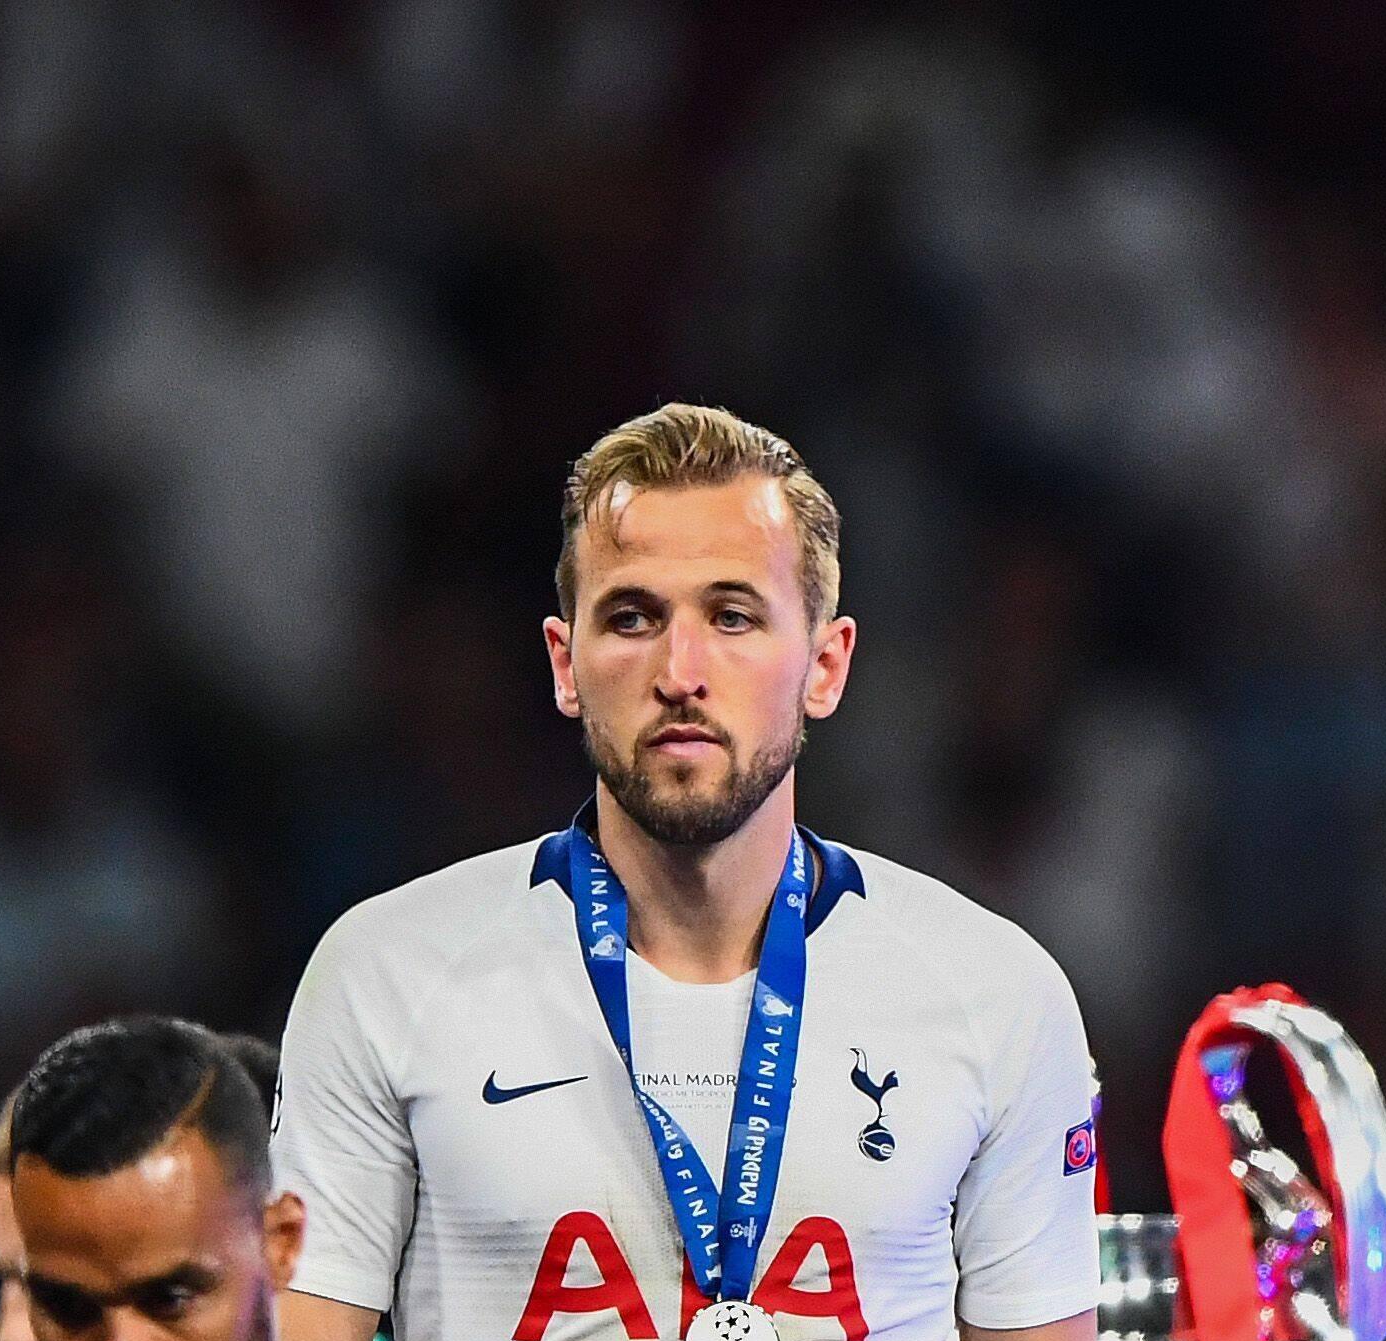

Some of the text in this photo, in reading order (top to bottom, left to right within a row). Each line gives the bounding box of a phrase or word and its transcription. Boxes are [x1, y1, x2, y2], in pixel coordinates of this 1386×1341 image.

[590, 852, 610, 933] FINAL
[686, 1074, 738, 1088] MADR
[753, 1024, 783, 1107] FINAL
[676, 1168, 720, 1257] FINAL
